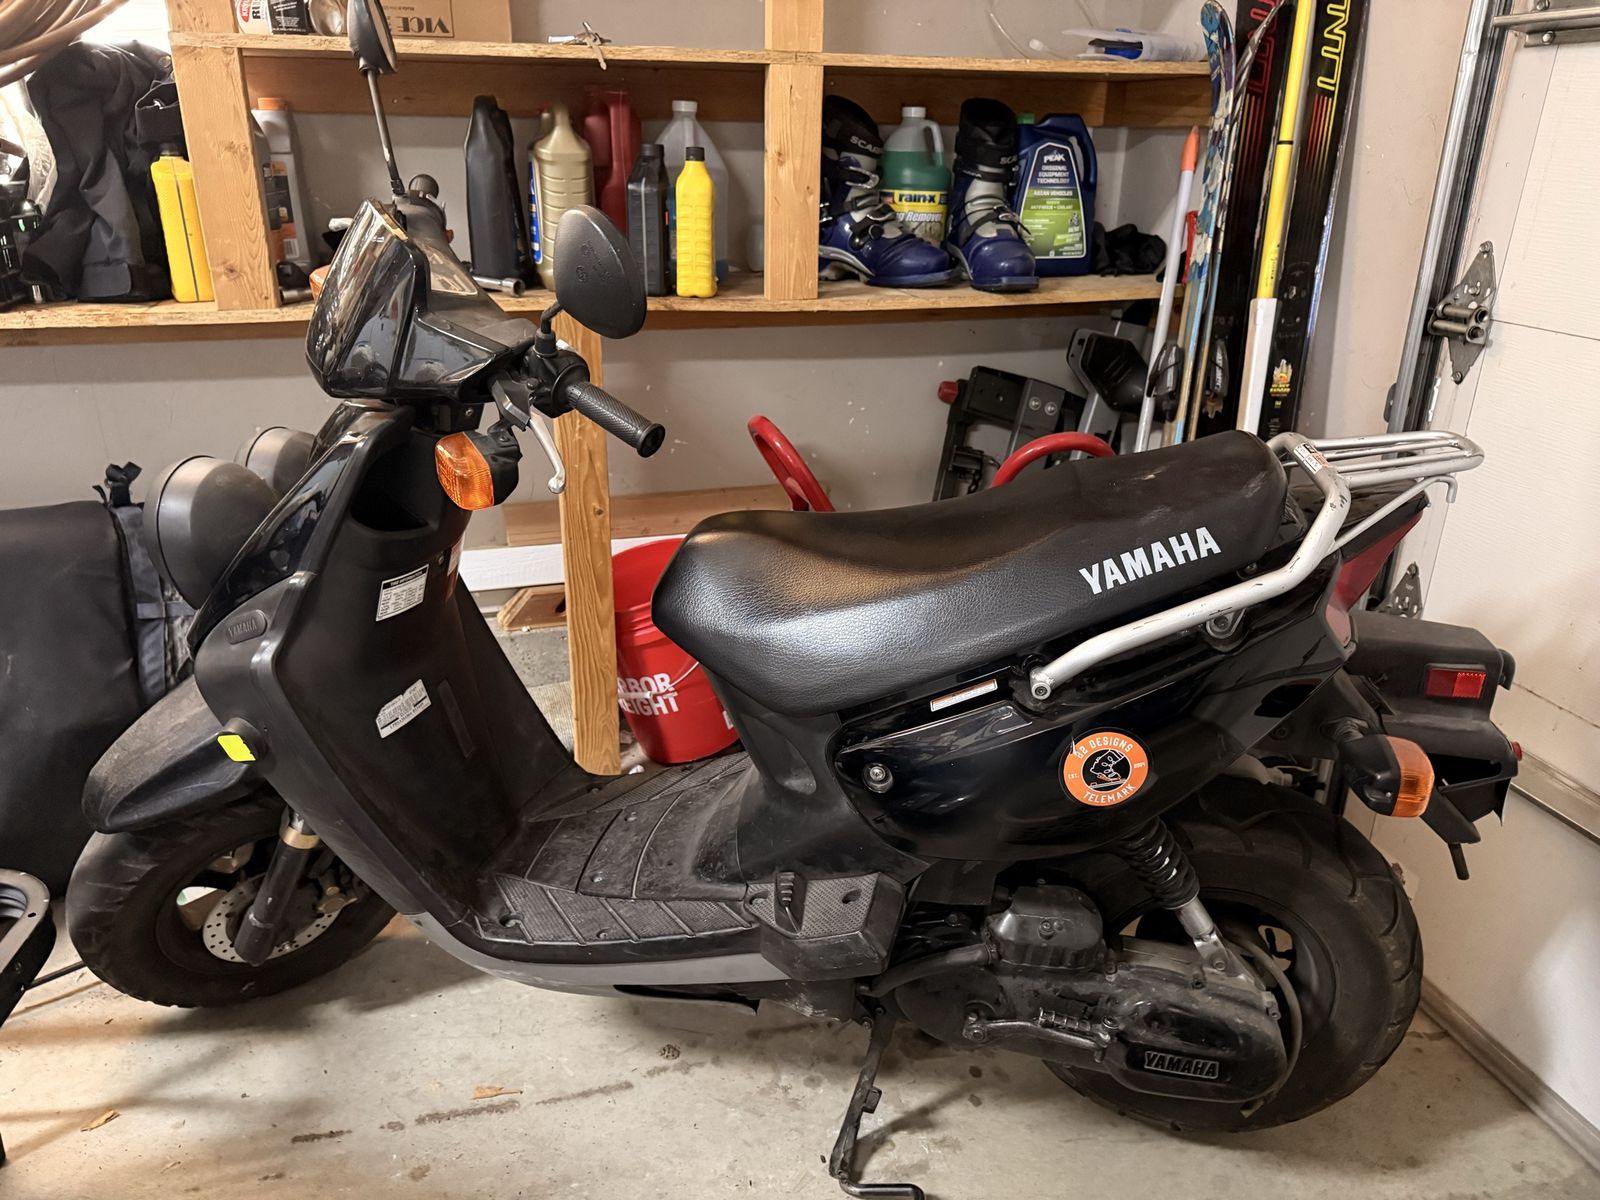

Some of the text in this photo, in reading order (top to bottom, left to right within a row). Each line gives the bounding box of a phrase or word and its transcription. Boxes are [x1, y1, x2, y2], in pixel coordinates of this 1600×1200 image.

[398, 16, 450, 34] VICE
[1043, 153, 1067, 163] PEAK
[1079, 526, 1221, 595] YAMAHA
[227, 617, 257, 638] YAMAHA
[1089, 737, 1133, 752] DESIGNS
[1083, 783, 1137, 804] TELEMARK
[1144, 1051, 1219, 1079] YAMAHA
